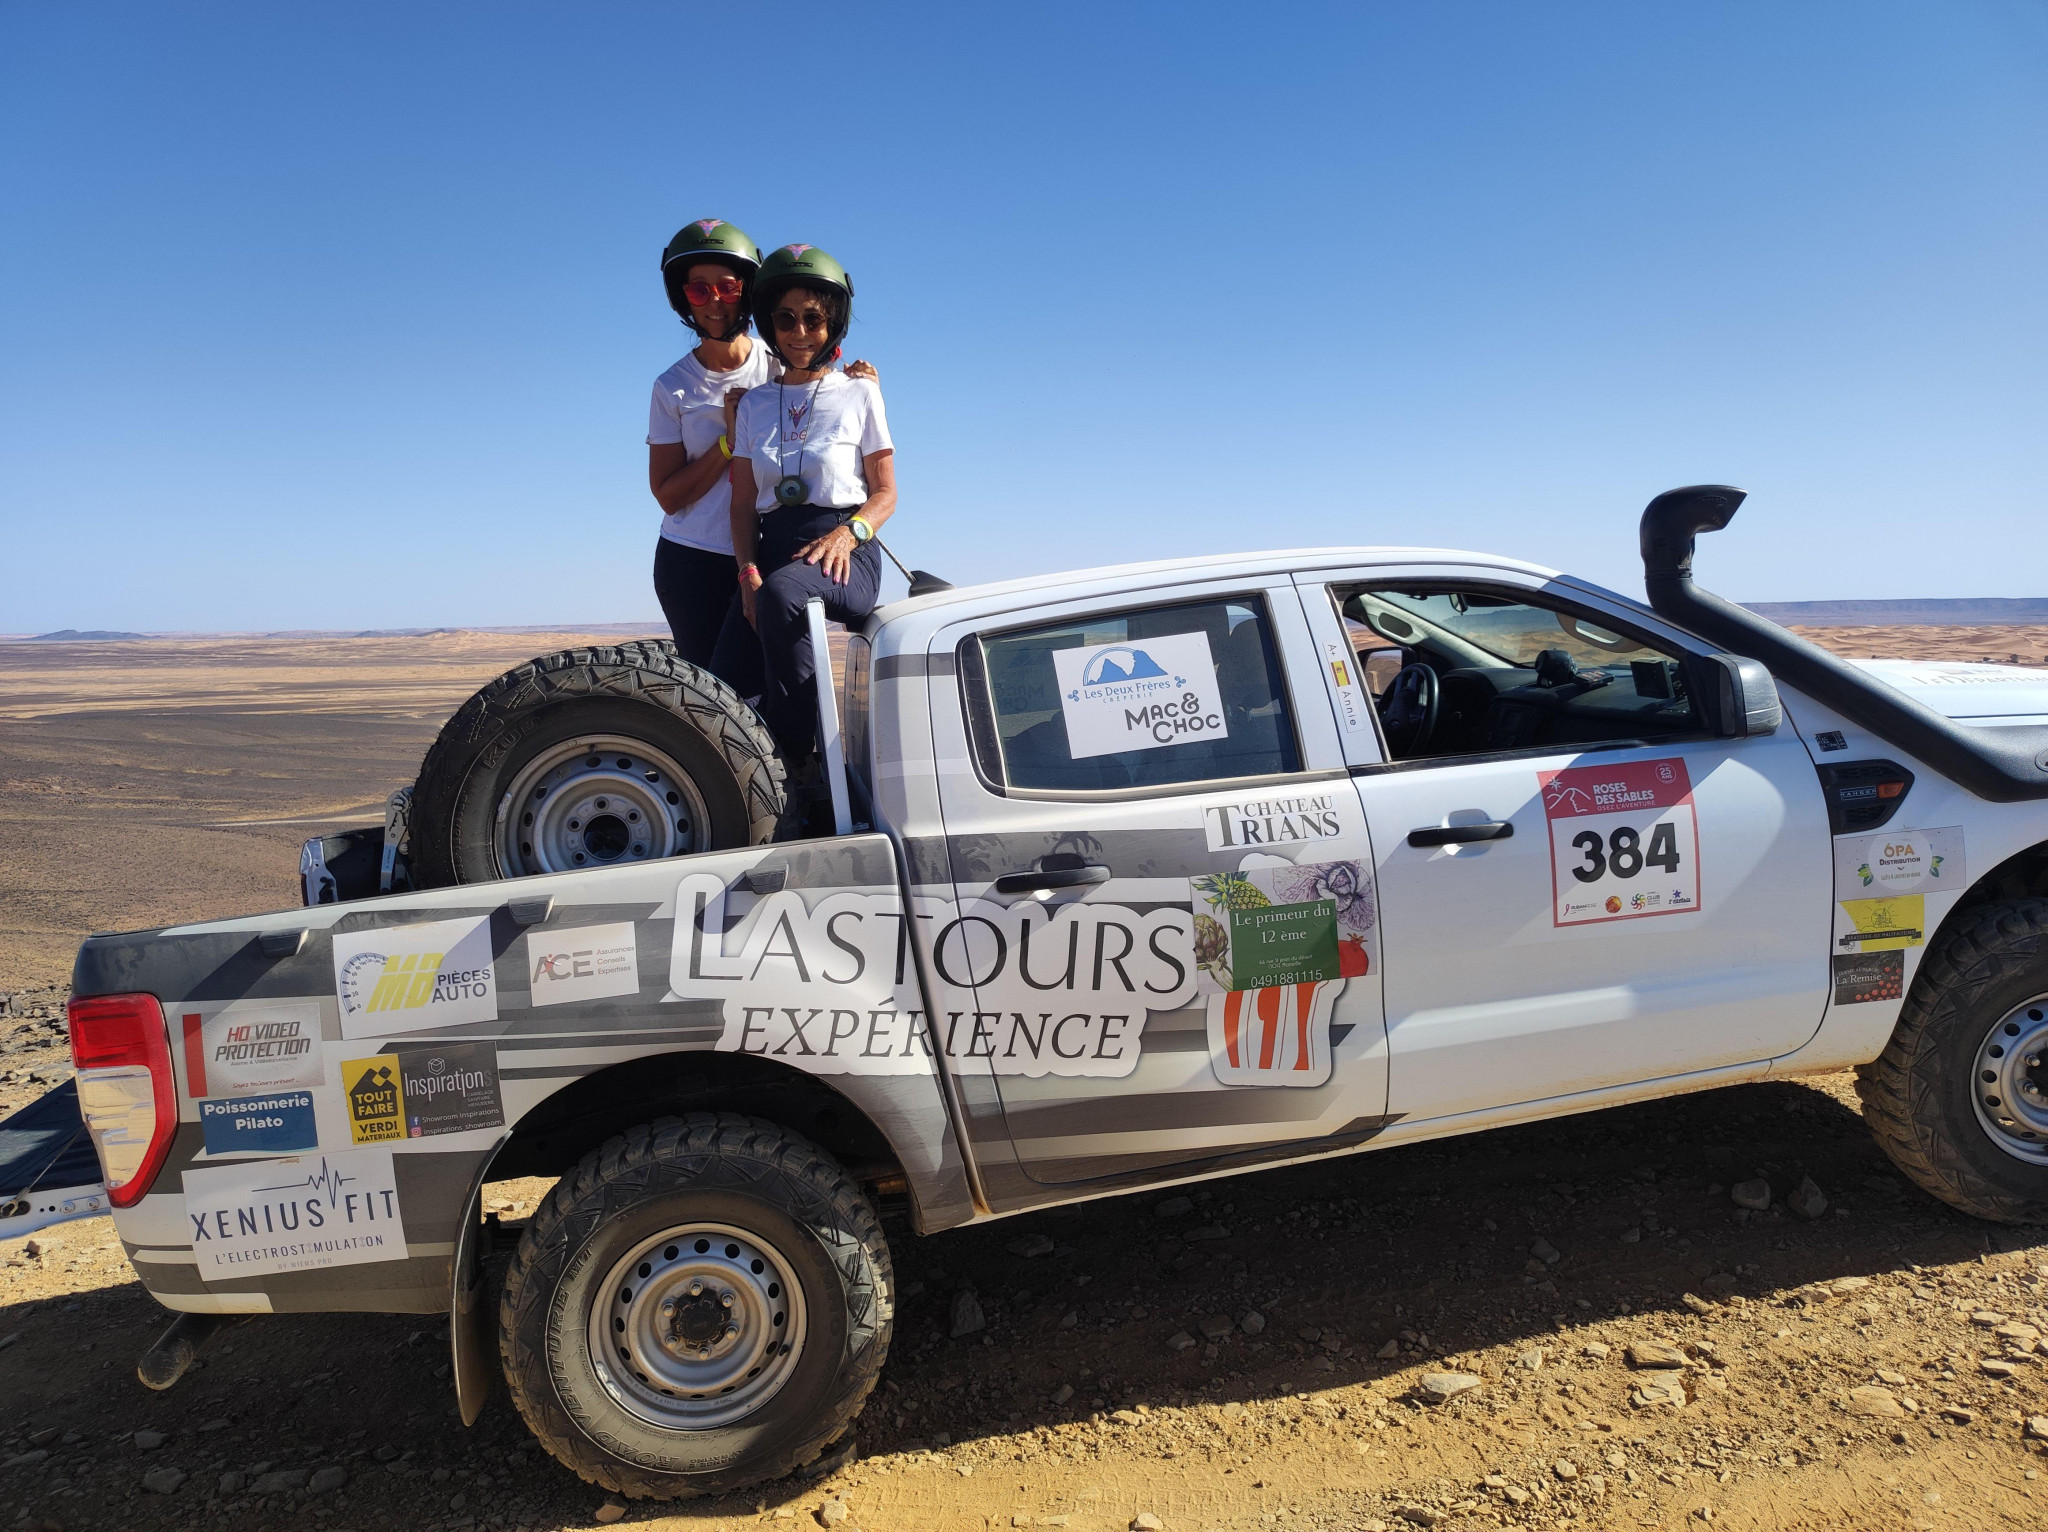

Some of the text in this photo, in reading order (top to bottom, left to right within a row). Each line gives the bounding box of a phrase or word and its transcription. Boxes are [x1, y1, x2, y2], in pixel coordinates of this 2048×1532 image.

[783, 429, 807, 443] LDG
[1084, 680, 1171, 699] Les Deux Frères
[1342, 691, 1357, 726] Annie
[1152, 713, 1221, 744] CHOC
[1659, 767, 1672, 776] 25
[1593, 782, 1627, 794] ROSES
[1595, 790, 1655, 805] DES SABLES
[1616, 800, 1656, 810] L'AVENTURE
[1205, 804, 1340, 848] TRIANS
[1571, 822, 1680, 883] 384
[1879, 856, 1921, 866] DISTRIBUTION
[1234, 904, 1331, 928] Le primeur du
[689, 891, 1186, 994] LASTOURS
[1260, 928, 1307, 944] 12 ème
[532, 950, 594, 983] ACE
[598, 966, 631, 975] Expertises
[437, 968, 491, 986] PIÈCES
[1251, 969, 1323, 988] 0491881115
[1836, 973, 1882, 985] La Remise
[432, 982, 487, 1004] AUTO
[227, 1021, 300, 1042] HD VIDEO
[733, 996, 1129, 1060] EXPÉRIENCE
[215, 1038, 311, 1061] PROTECTION
[204, 1094, 310, 1116] Poissonnerie
[355, 1090, 392, 1104] TOUT
[357, 1102, 395, 1117] FAIRE
[422, 1112, 459, 1123] Showroom
[460, 1107, 500, 1119] Inspirations
[235, 1117, 283, 1131] Pilato
[359, 1121, 398, 1134] VERDI
[357, 1132, 401, 1143] MATERIAUX
[190, 1190, 394, 1242] XENIUS FIT
[216, 1235, 384, 1265] L'ELECTROSTIMULATION
[278, 1262, 287, 1270] BY
[318, 1257, 332, 1266] PRO
[549, 1286, 592, 1430] VENTURE
[594, 1430, 681, 1468] ROAD
